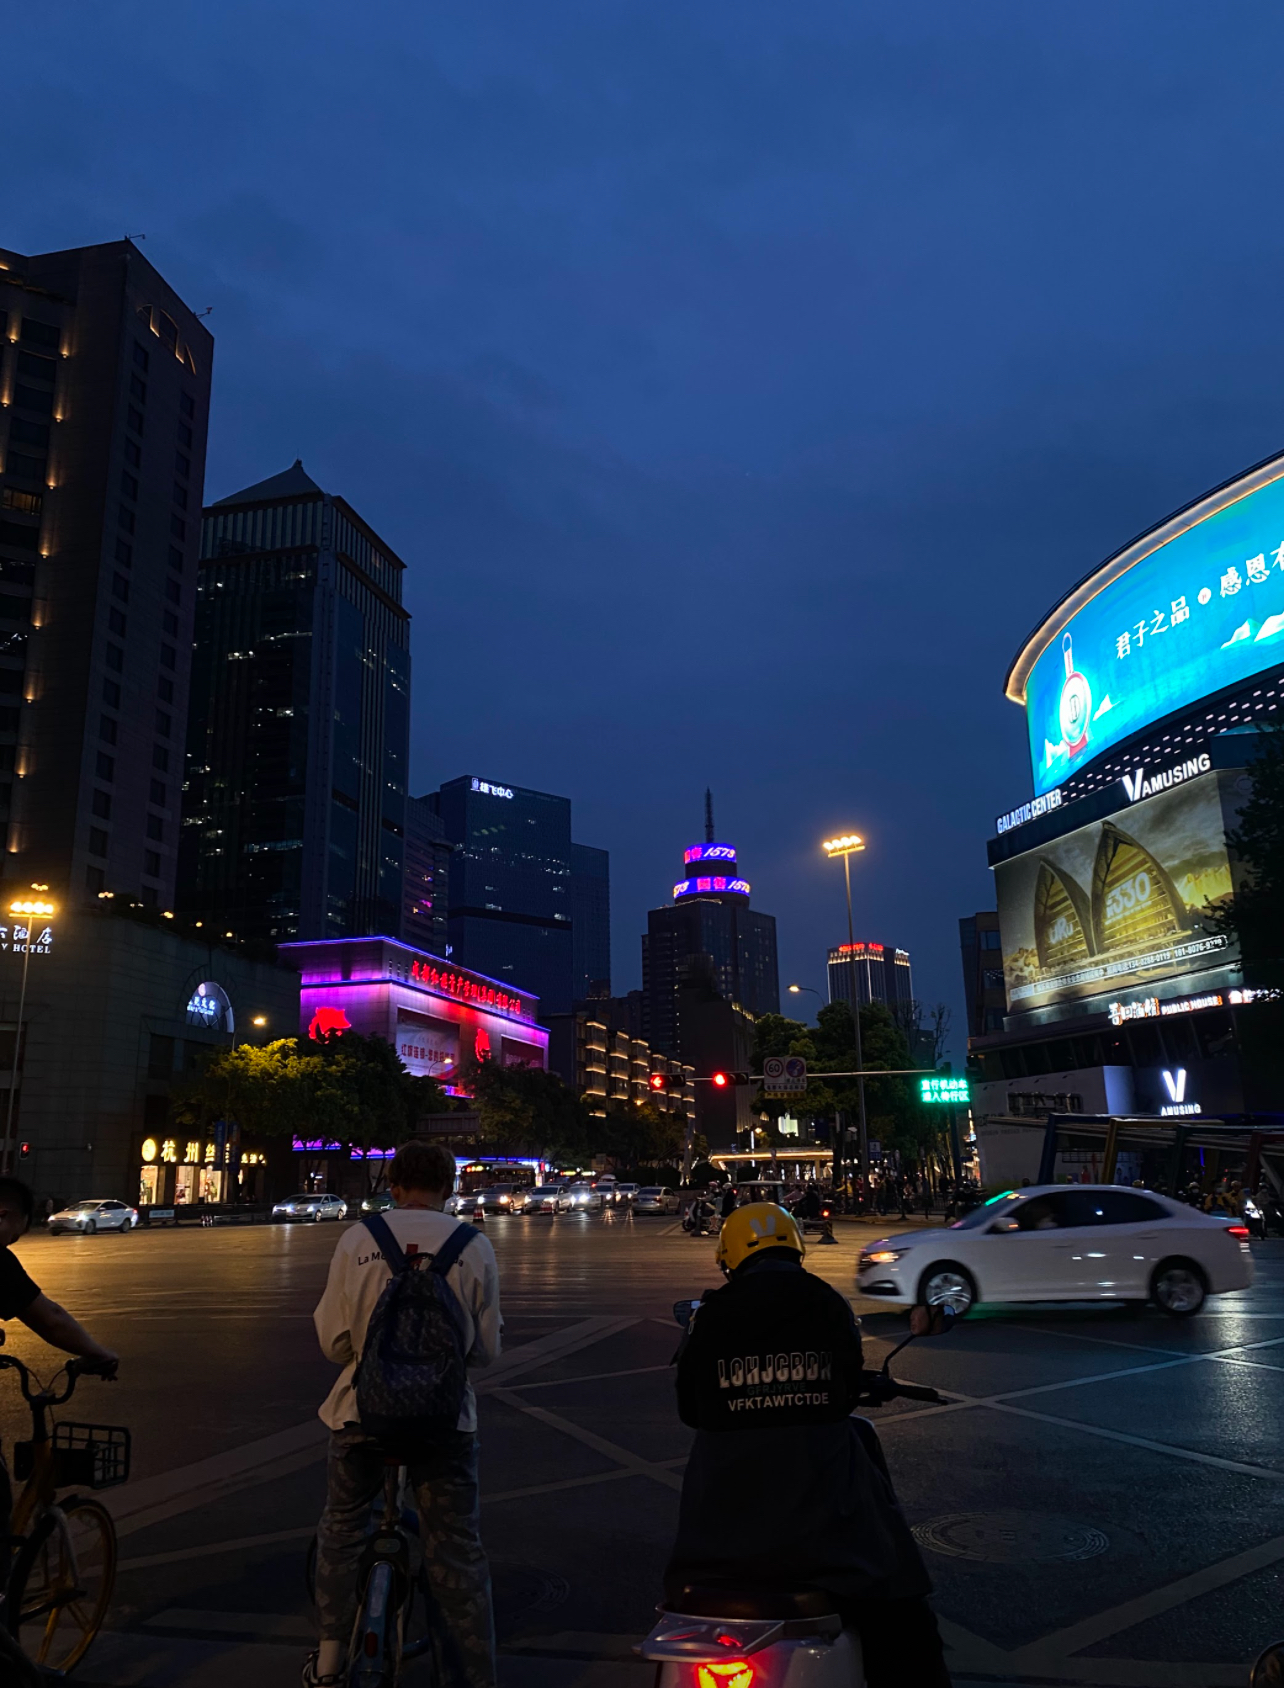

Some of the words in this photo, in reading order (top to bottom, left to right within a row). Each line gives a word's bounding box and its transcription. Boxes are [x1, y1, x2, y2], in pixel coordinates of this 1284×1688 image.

[1115, 596, 1189, 659] 君子之品
[997, 801, 1032, 834] GALACTIC
[1031, 788, 1062, 820] CENTER
[703, 847, 736, 858] 1573
[12, 944, 51, 954] HOTEL
[1161, 1001, 1190, 1015] PUBLIC
[1190, 995, 1222, 1010] HOUSE
[768, 1063, 780, 1073] 60
[1160, 1103, 1202, 1117] AMUSING
[358, 1255, 369, 1266] La
[727, 1392, 830, 1412] VFKTAWTCTDE
